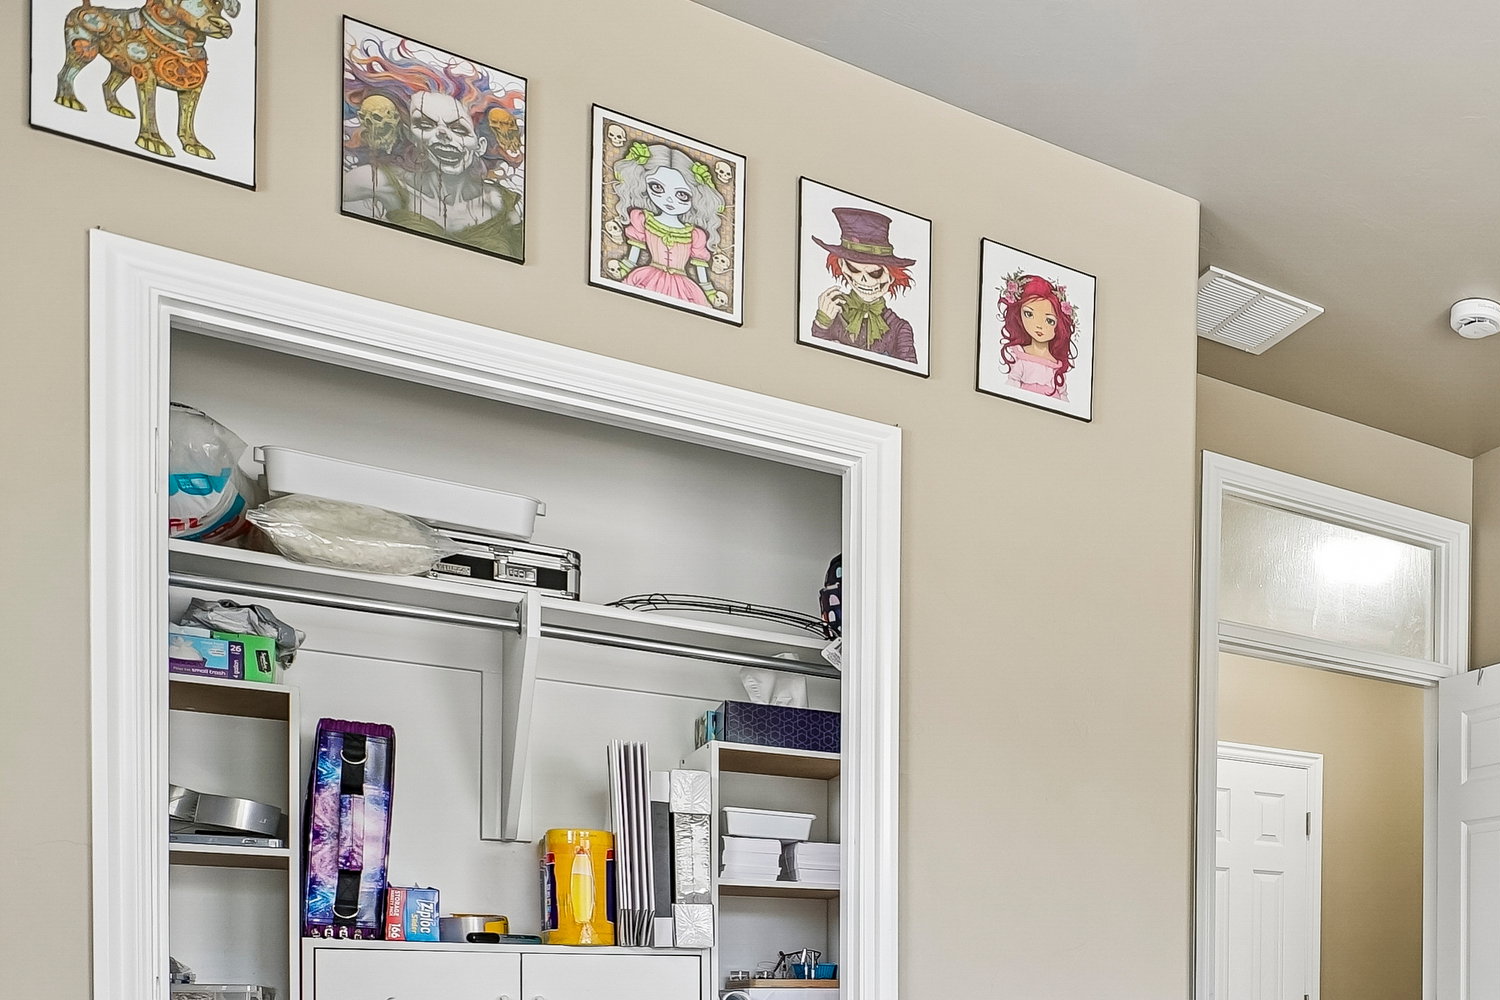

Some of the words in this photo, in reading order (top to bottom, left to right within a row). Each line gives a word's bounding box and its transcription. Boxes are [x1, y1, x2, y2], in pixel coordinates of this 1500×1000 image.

[230, 644, 242, 653] 26
[393, 890, 401, 917] STORAGE
[416, 902, 434, 934] Ziploc
[391, 923, 401, 938] 166
